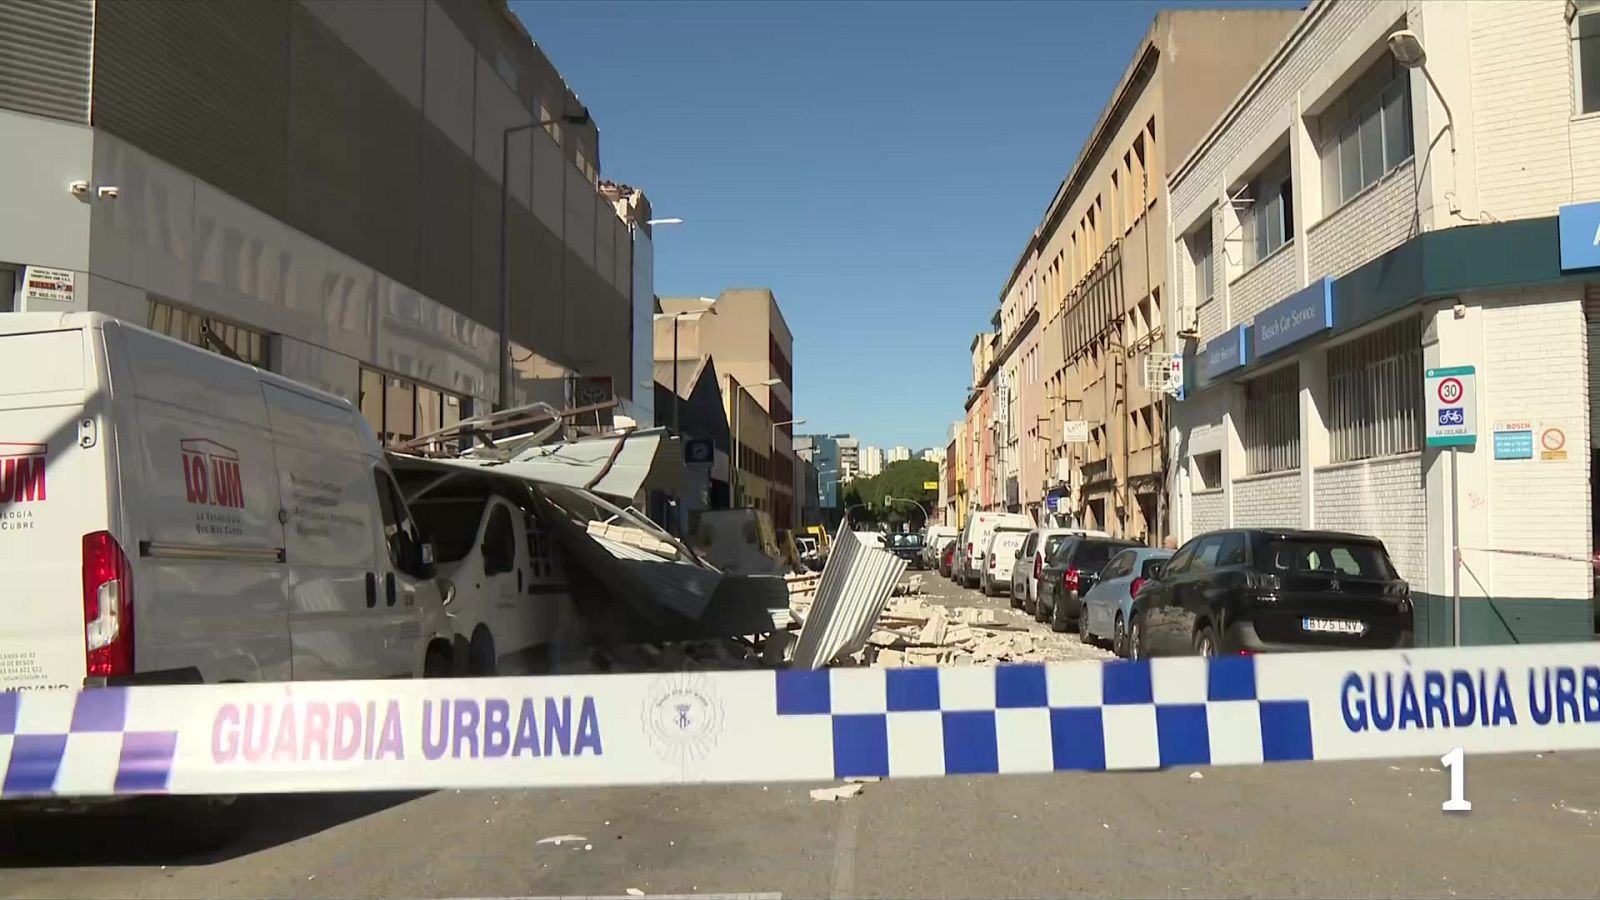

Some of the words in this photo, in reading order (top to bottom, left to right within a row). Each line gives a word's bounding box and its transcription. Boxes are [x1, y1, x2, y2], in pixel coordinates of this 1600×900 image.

[1261, 319, 1281, 341] Bosch
[1280, 315, 1291, 333] Car
[1291, 306, 1316, 327] Service
[1443, 384, 1457, 398] 30
[1338, 620, 1357, 631] LNV
[1340, 653, 1517, 733] GUÀRDIA
[210, 685, 405, 765] GUÀRDIA
[421, 696, 603, 761] URBANA
